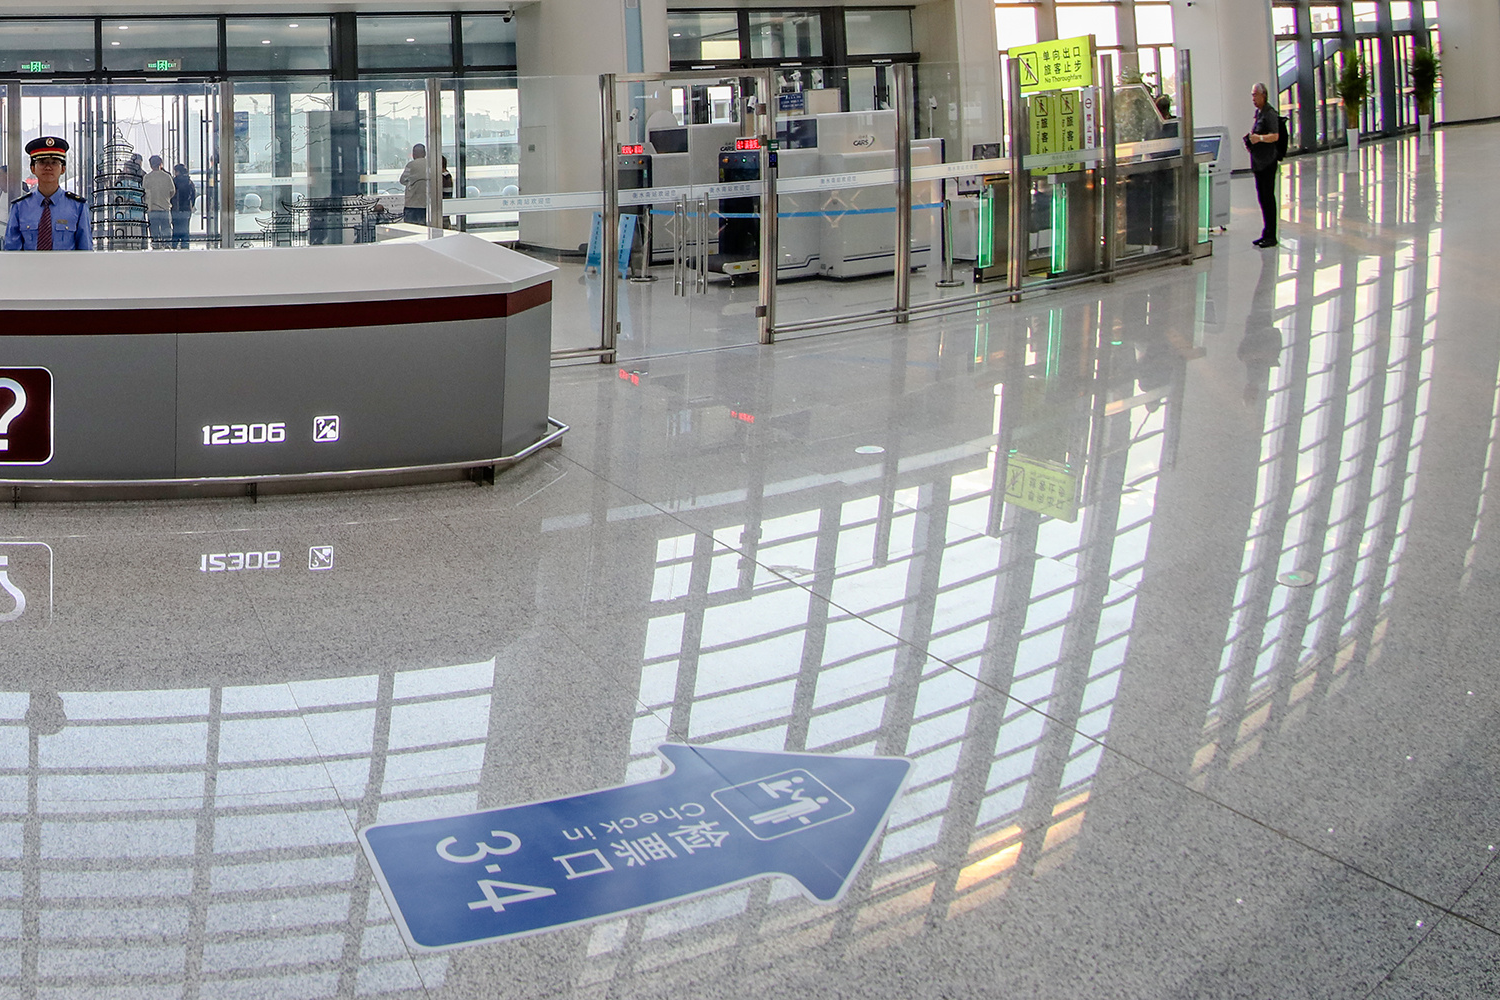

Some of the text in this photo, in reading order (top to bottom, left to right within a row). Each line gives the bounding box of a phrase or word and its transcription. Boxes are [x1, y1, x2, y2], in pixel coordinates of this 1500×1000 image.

[1042, 46, 1080, 61] 单向出口
[1043, 60, 1082, 76] 旅客止步
[1052, 74, 1082, 83] Thoroughfare
[502, 197, 551, 206] 衡水南站欢迎您
[203, 422, 286, 446] 12306
[562, 803, 706, 841] Check in
[553, 820, 731, 880] 检票口
